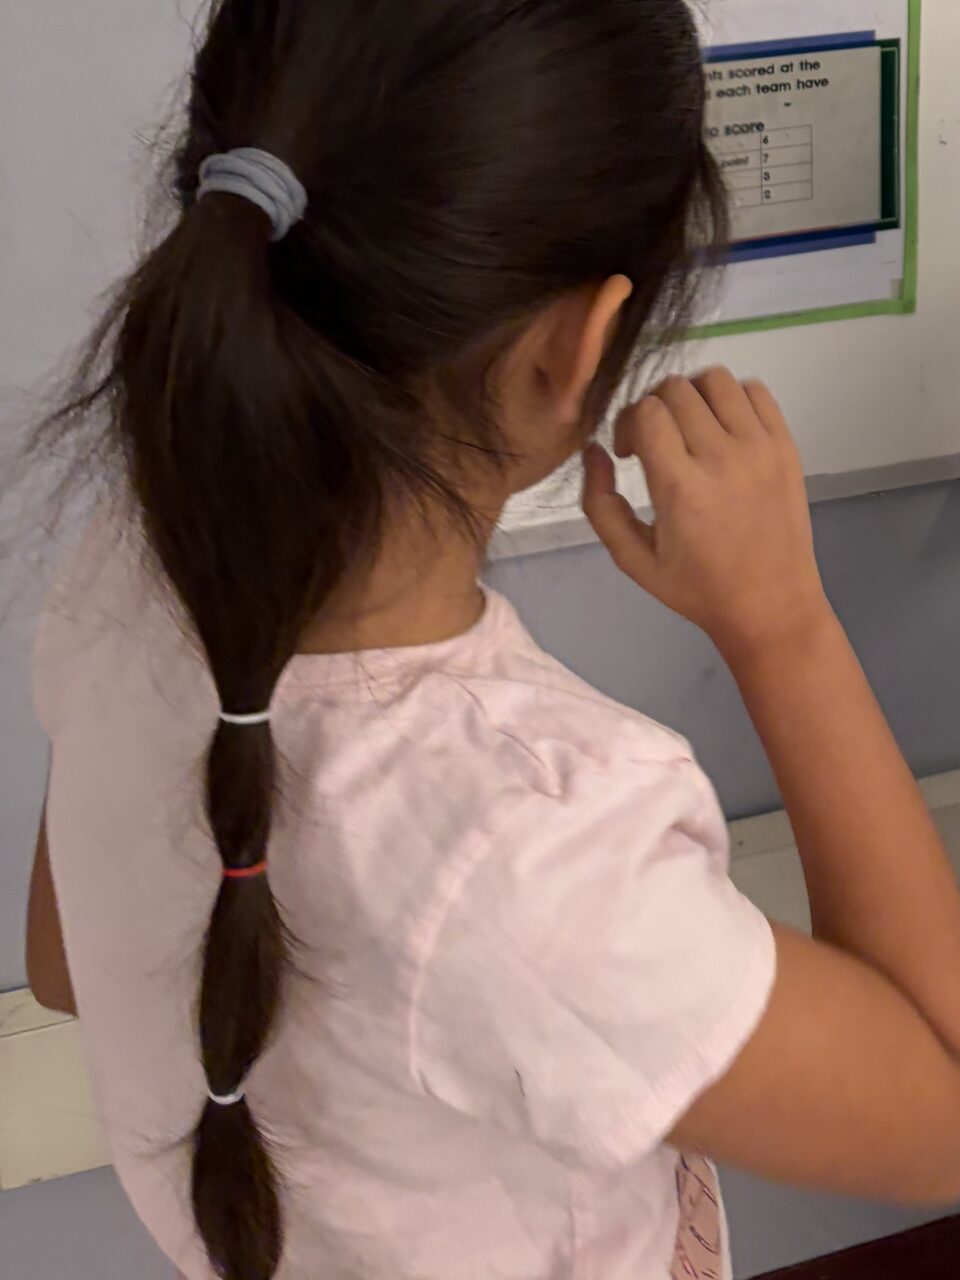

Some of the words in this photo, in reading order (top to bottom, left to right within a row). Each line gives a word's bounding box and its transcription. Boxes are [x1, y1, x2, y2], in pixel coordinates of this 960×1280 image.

[728, 64, 775, 79] scored
[780, 62, 794, 73] at
[800, 60, 821, 71] the
[716, 85, 751, 98] each
[757, 83, 792, 94] team
[797, 78, 829, 90] have
[724, 121, 765, 136] score
